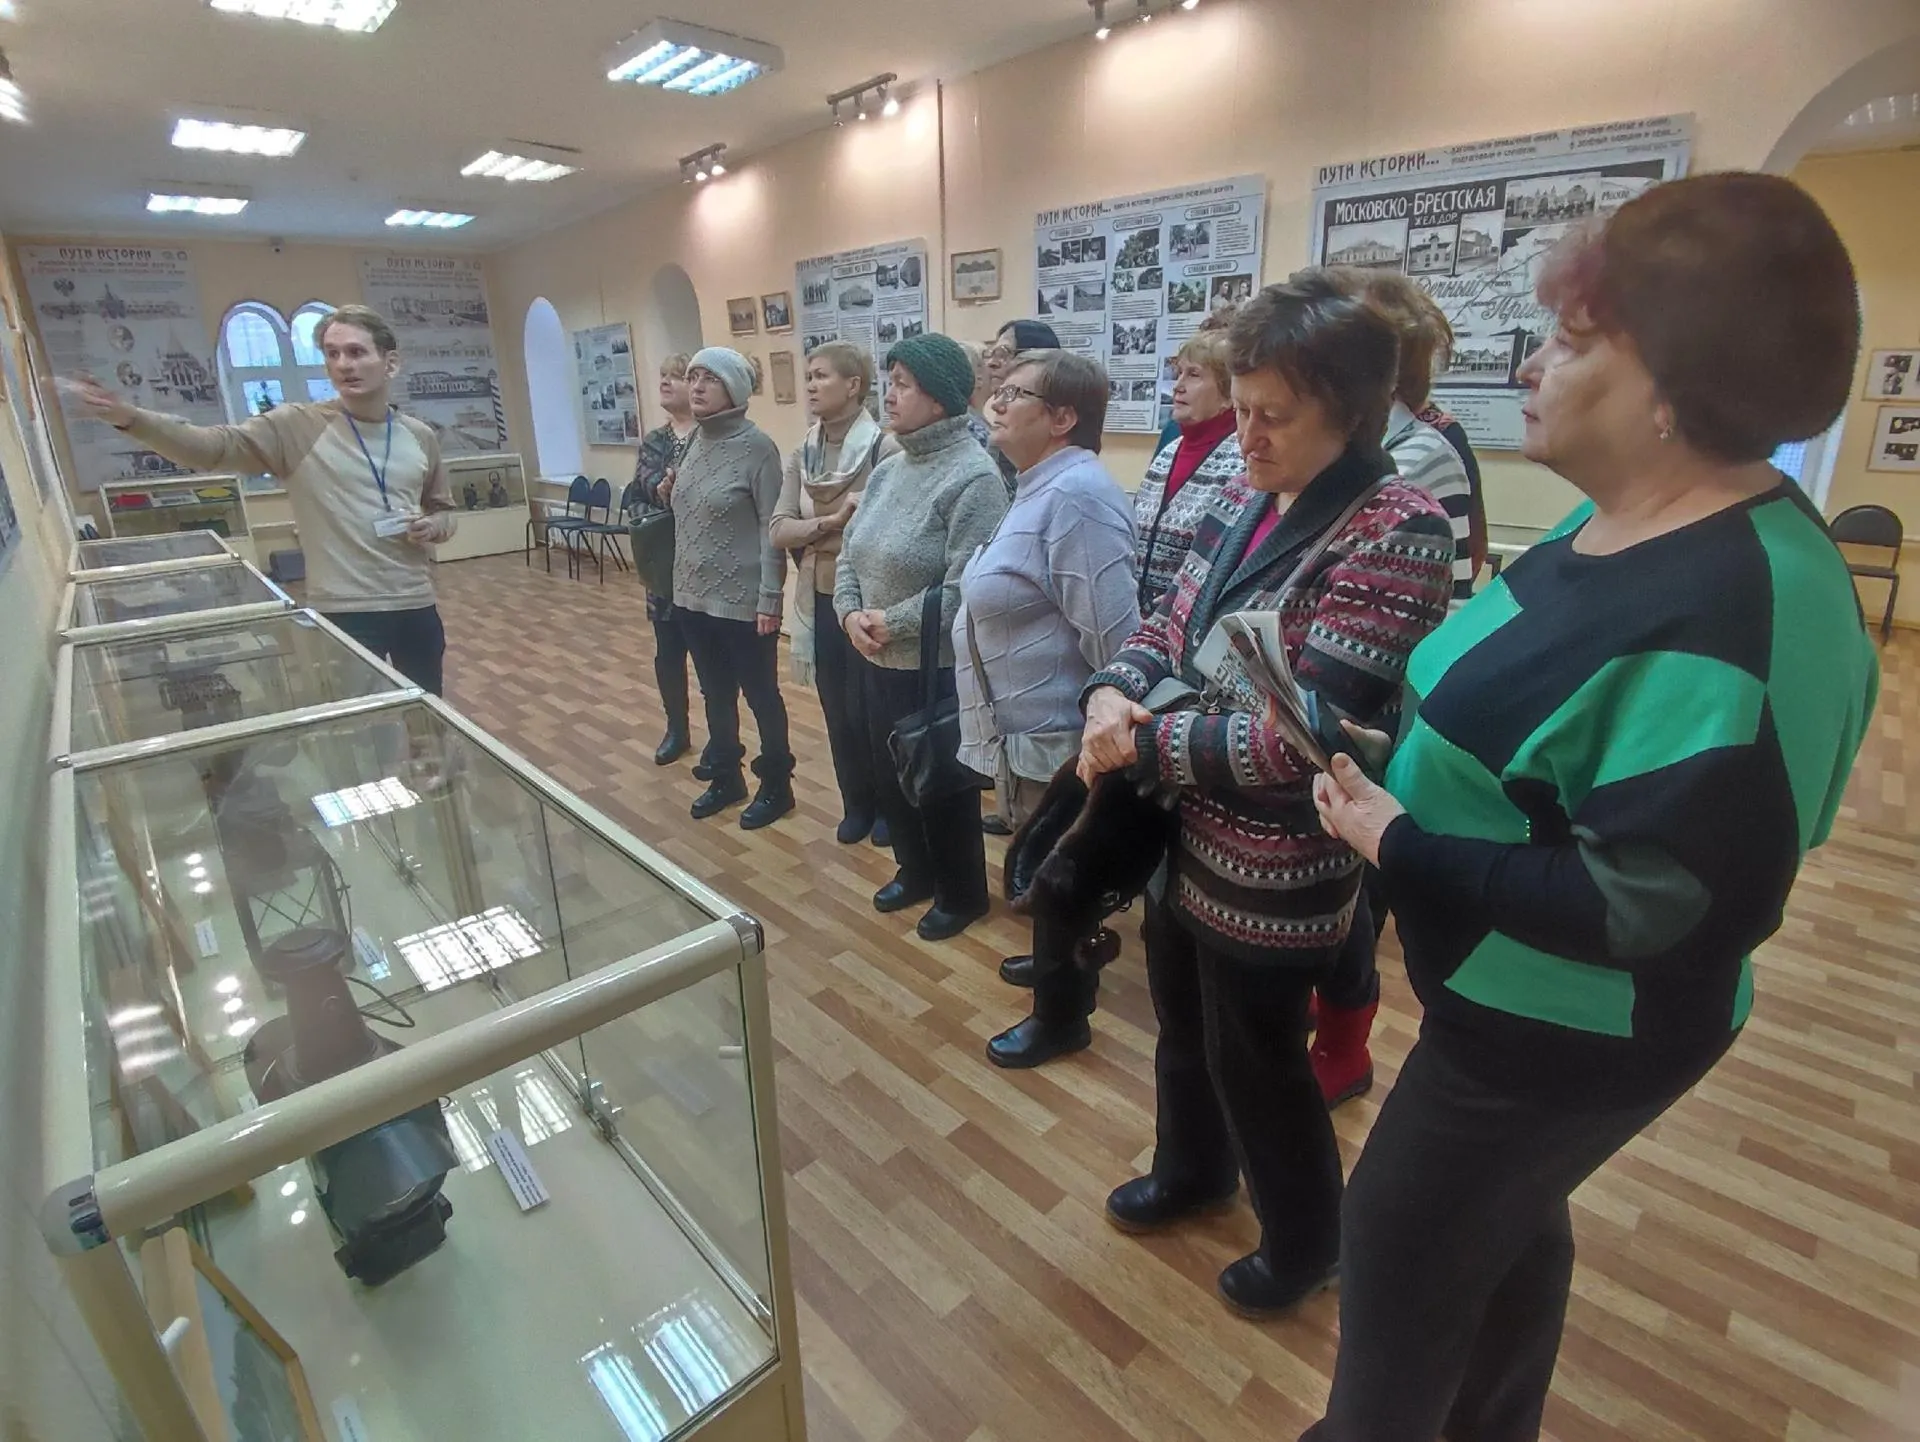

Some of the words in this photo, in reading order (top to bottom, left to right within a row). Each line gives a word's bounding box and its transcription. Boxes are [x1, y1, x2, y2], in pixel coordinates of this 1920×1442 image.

[1318, 162, 1355, 185] ПУТИ
[1036, 209, 1060, 227] ПУТИ
[59, 248, 92, 260] ПУТИ
[99, 248, 152, 260] ИСТОРИИ
